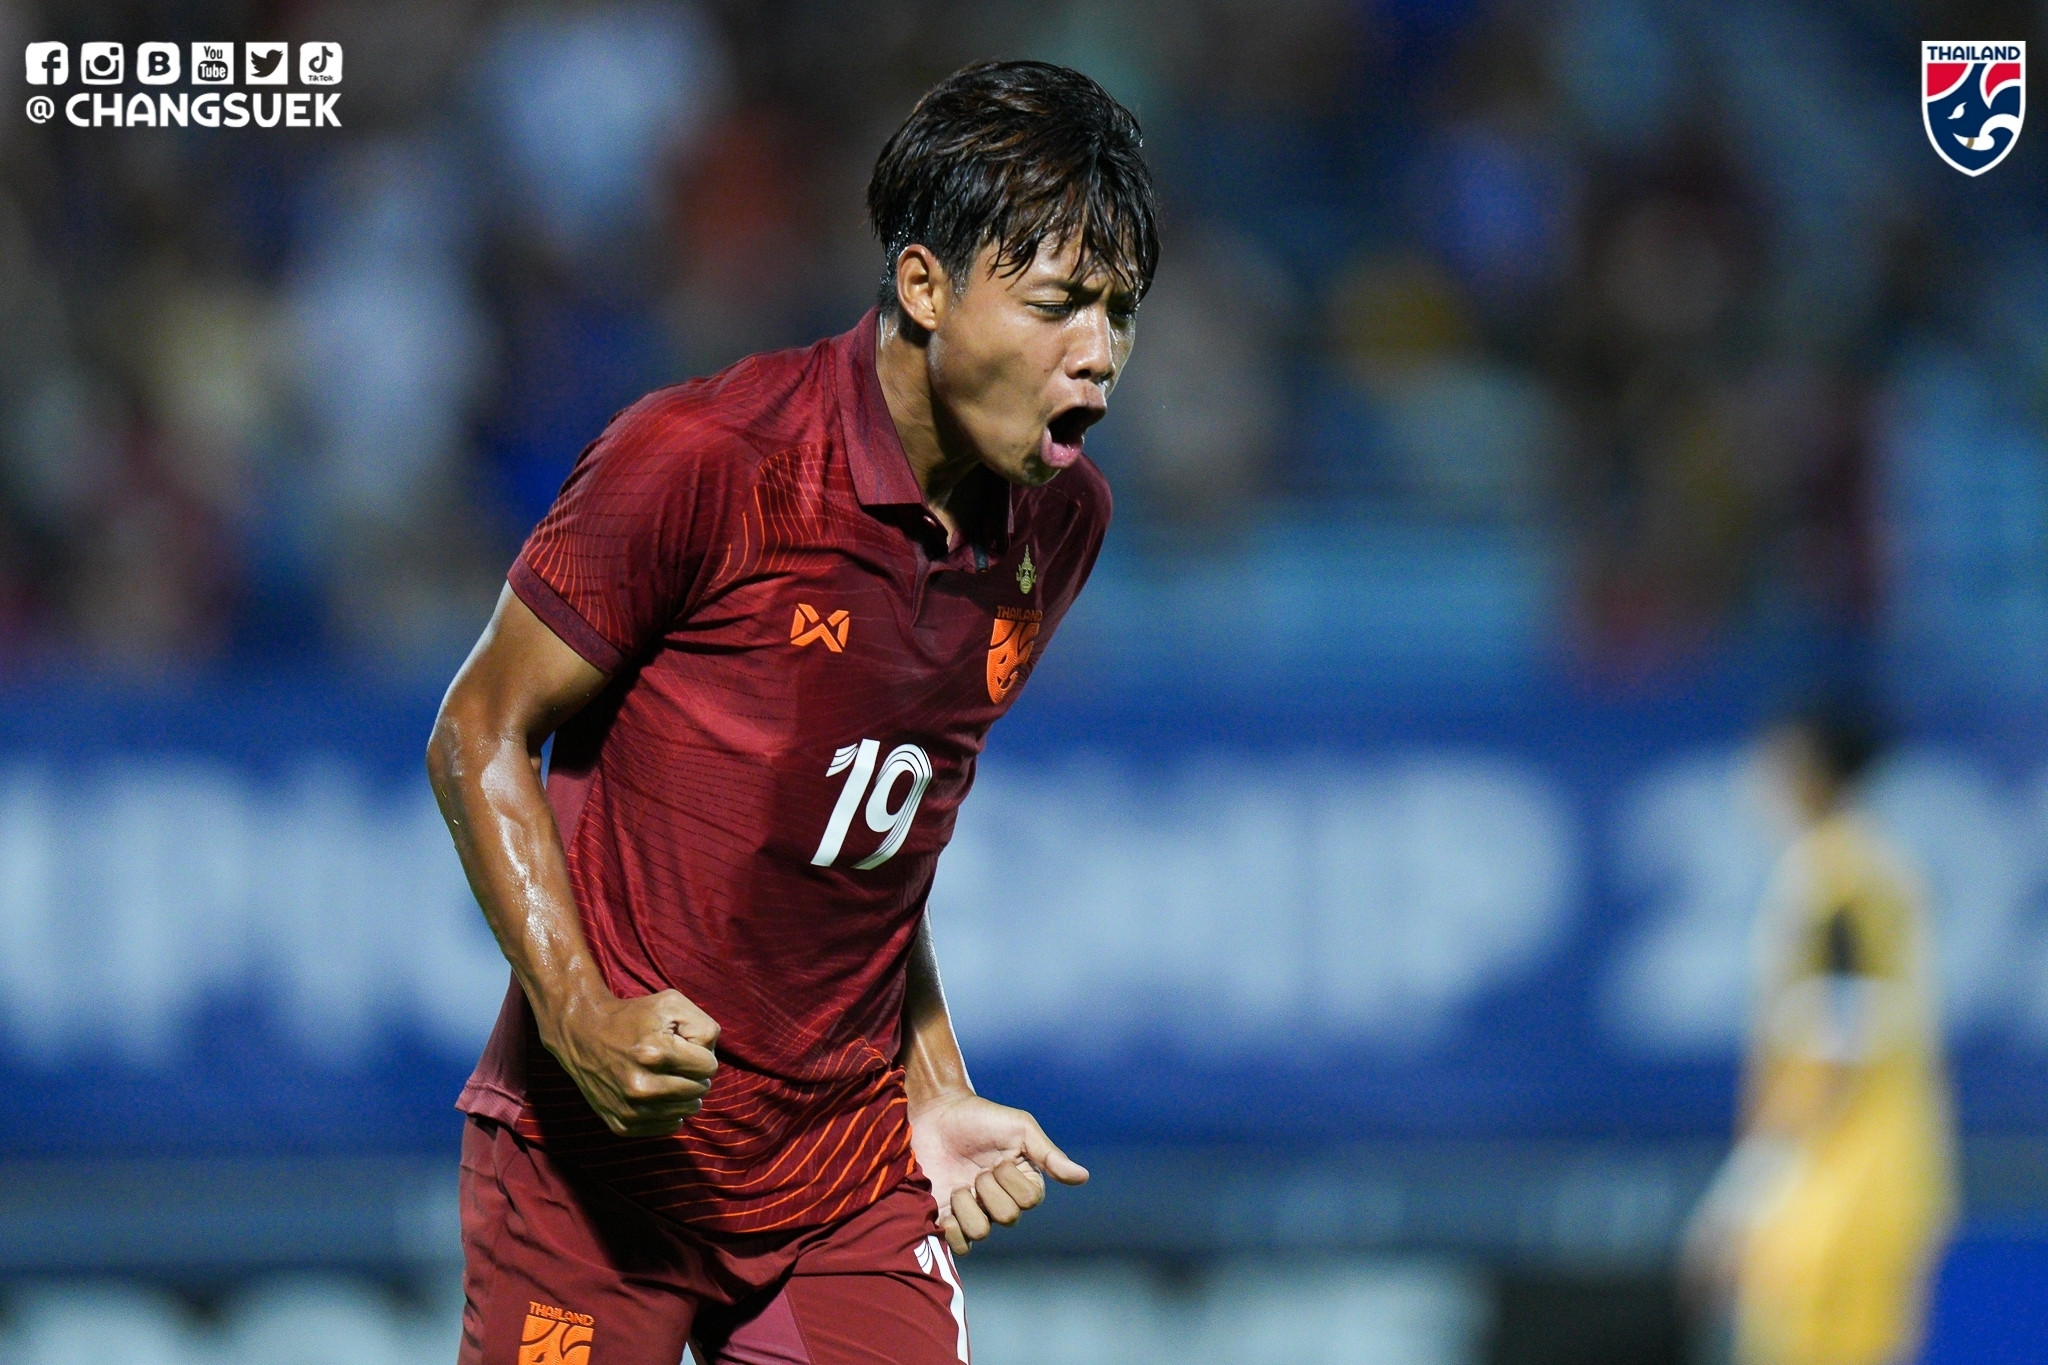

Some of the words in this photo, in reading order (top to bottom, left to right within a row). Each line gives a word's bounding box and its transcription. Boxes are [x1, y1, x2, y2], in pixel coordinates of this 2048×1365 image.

[996, 605, 1043, 621] THAILAND
[810, 738, 933, 870] 19
[529, 1301, 595, 1326] THAILAND
